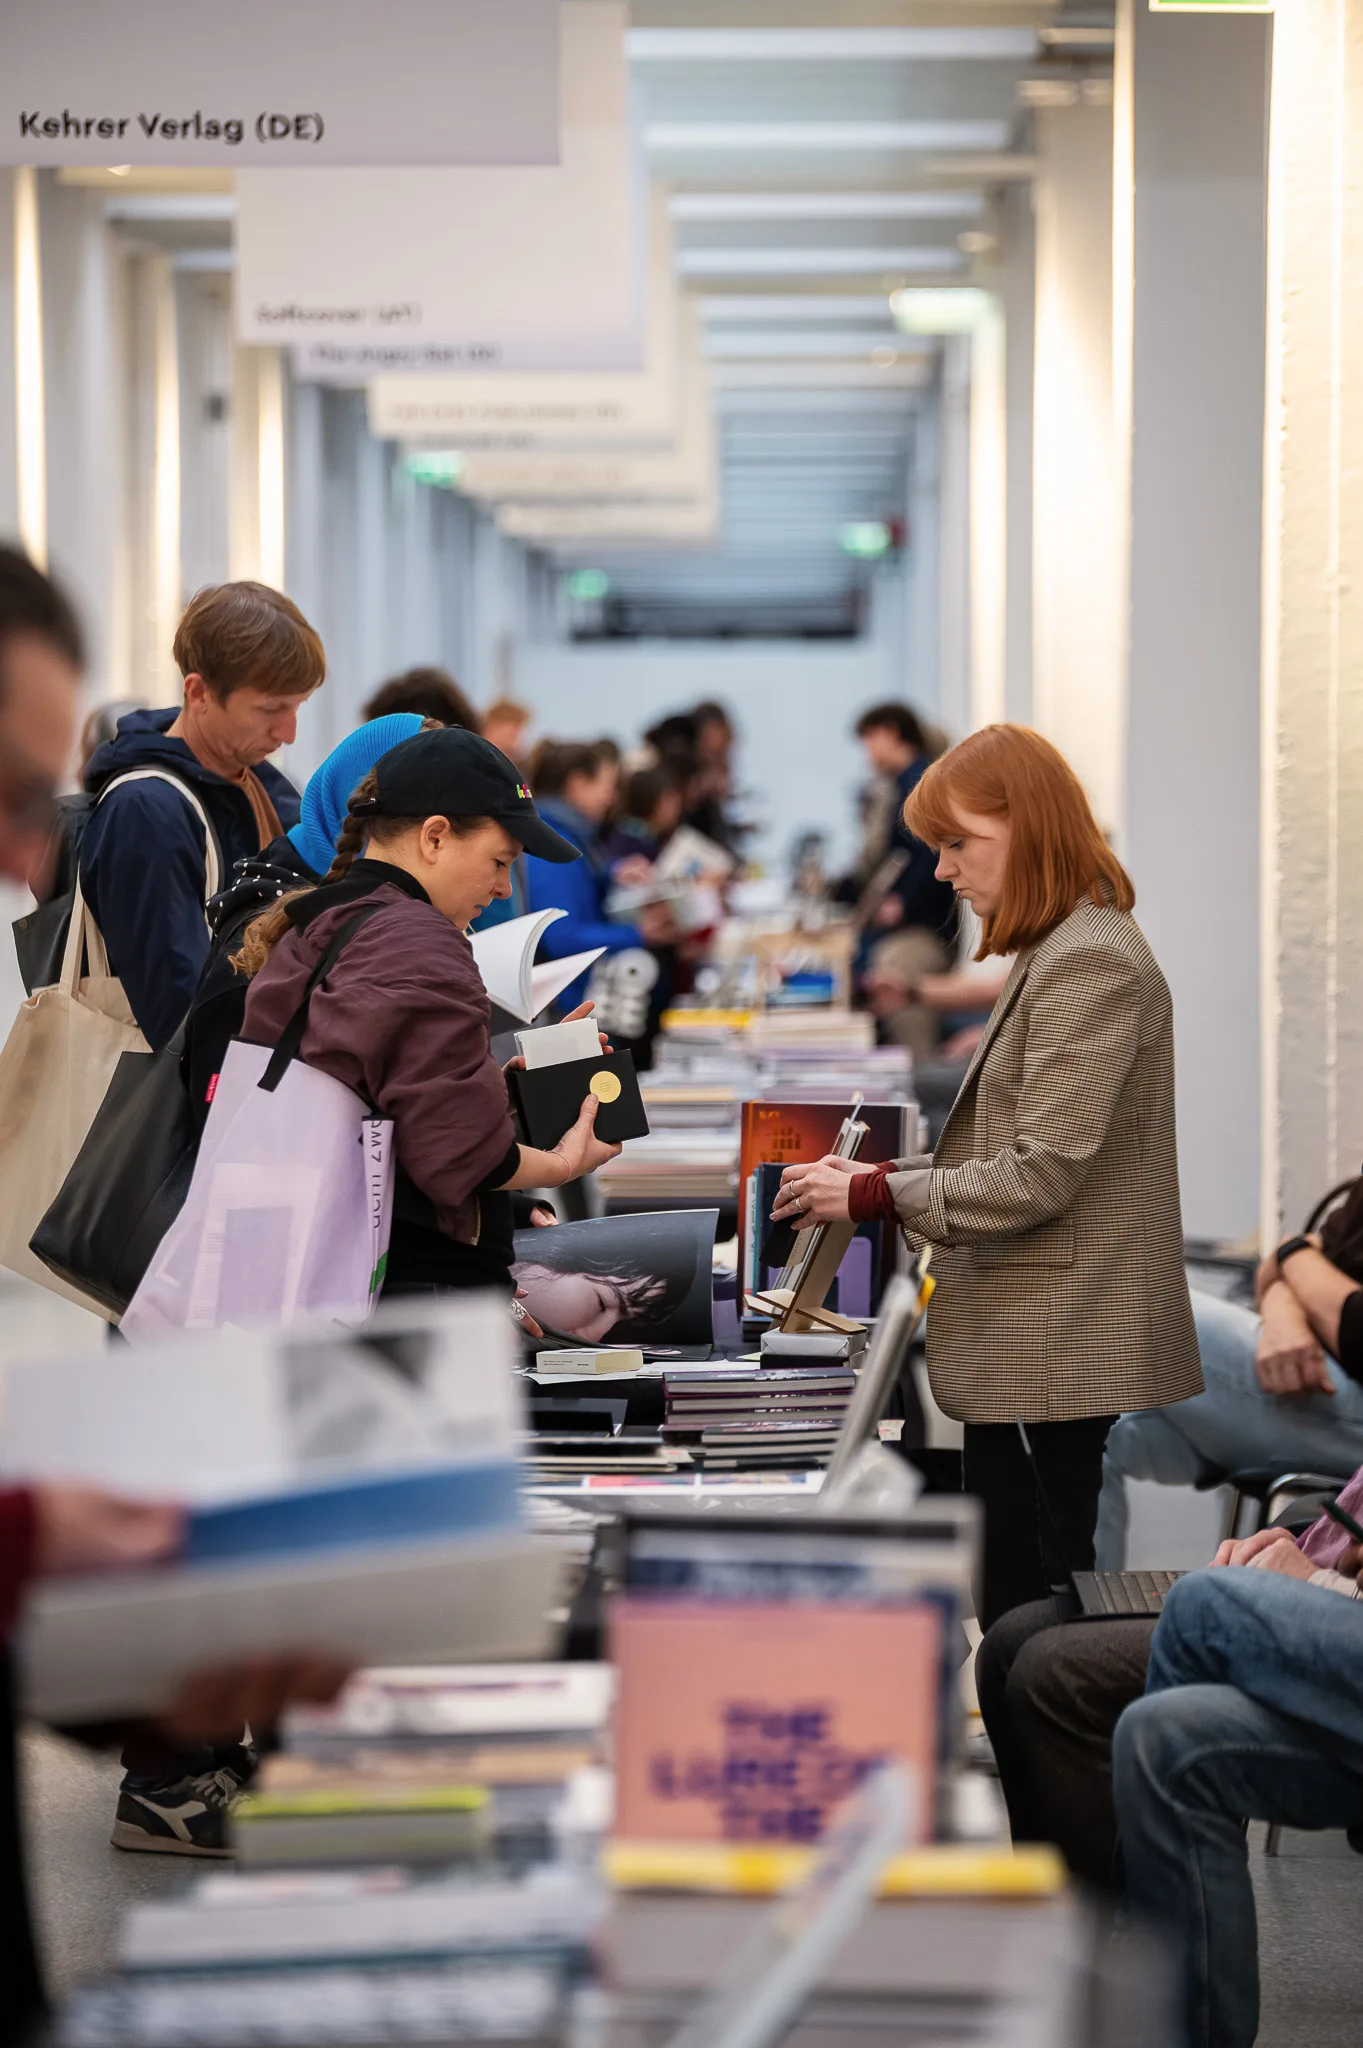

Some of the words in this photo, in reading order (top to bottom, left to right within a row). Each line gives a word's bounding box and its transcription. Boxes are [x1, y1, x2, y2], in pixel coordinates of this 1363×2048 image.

[19, 109, 129, 140] Kehrer
[138, 109, 244, 146] Verlag
[255, 111, 325, 143] (DE)
